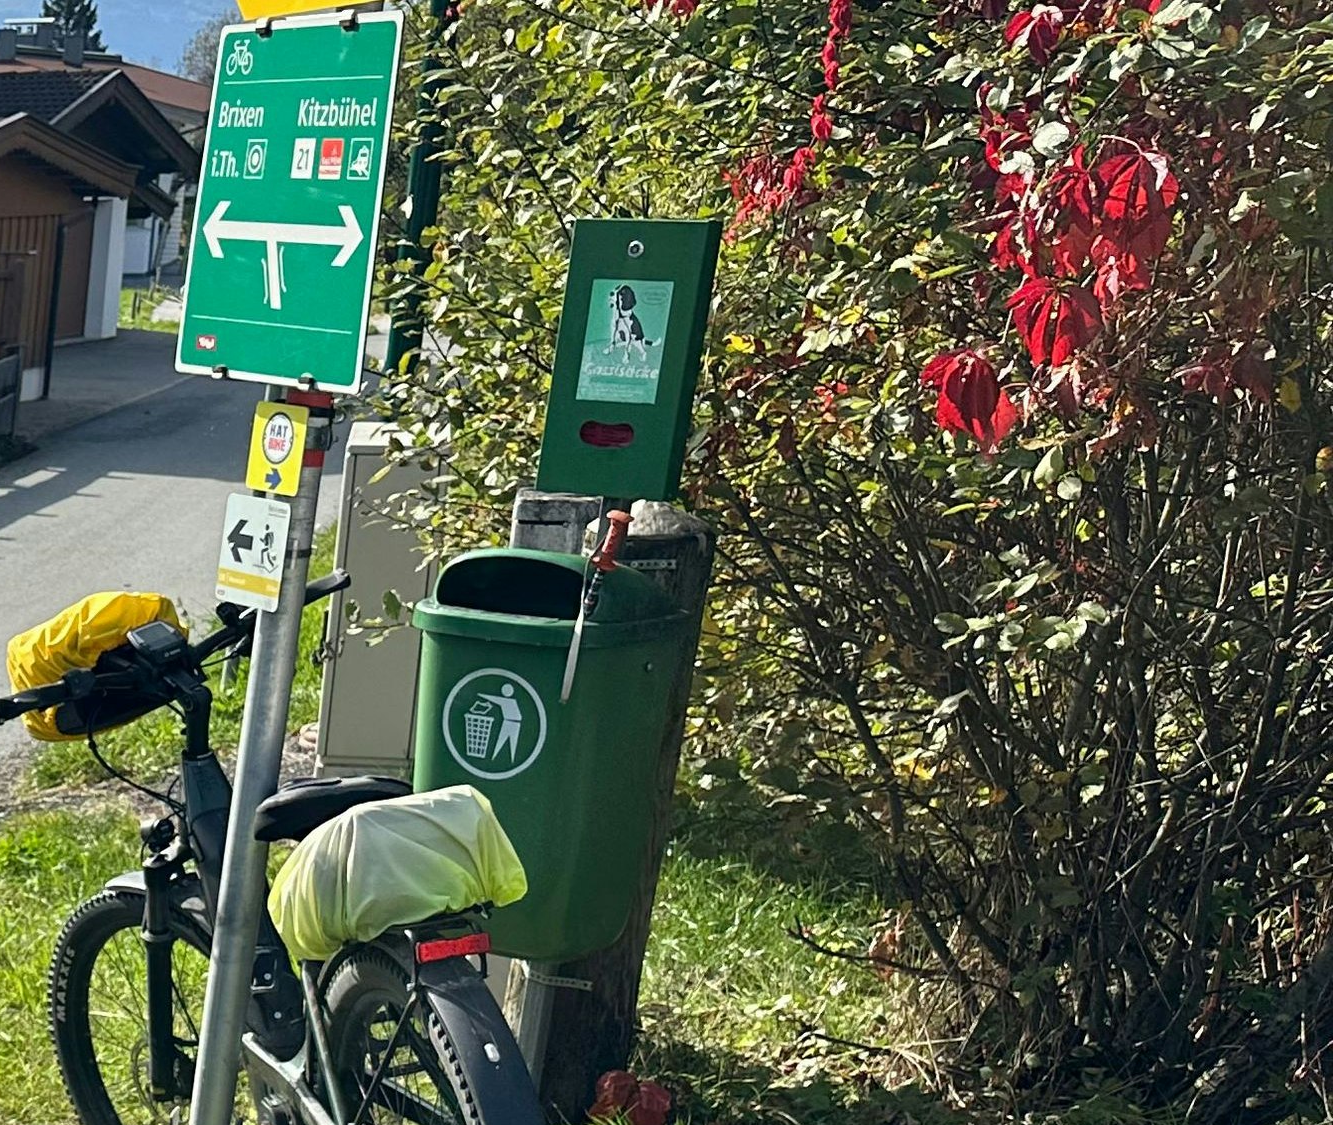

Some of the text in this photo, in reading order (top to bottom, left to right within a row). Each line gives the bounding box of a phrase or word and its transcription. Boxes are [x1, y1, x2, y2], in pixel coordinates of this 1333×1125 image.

[218, 99, 265, 128] Brixen
[297, 96, 378, 127] Kitzbühel
[211, 148, 240, 178] i.Th.
[296, 148, 310, 170] 21
[56, 945, 76, 1023] MAXXIS
